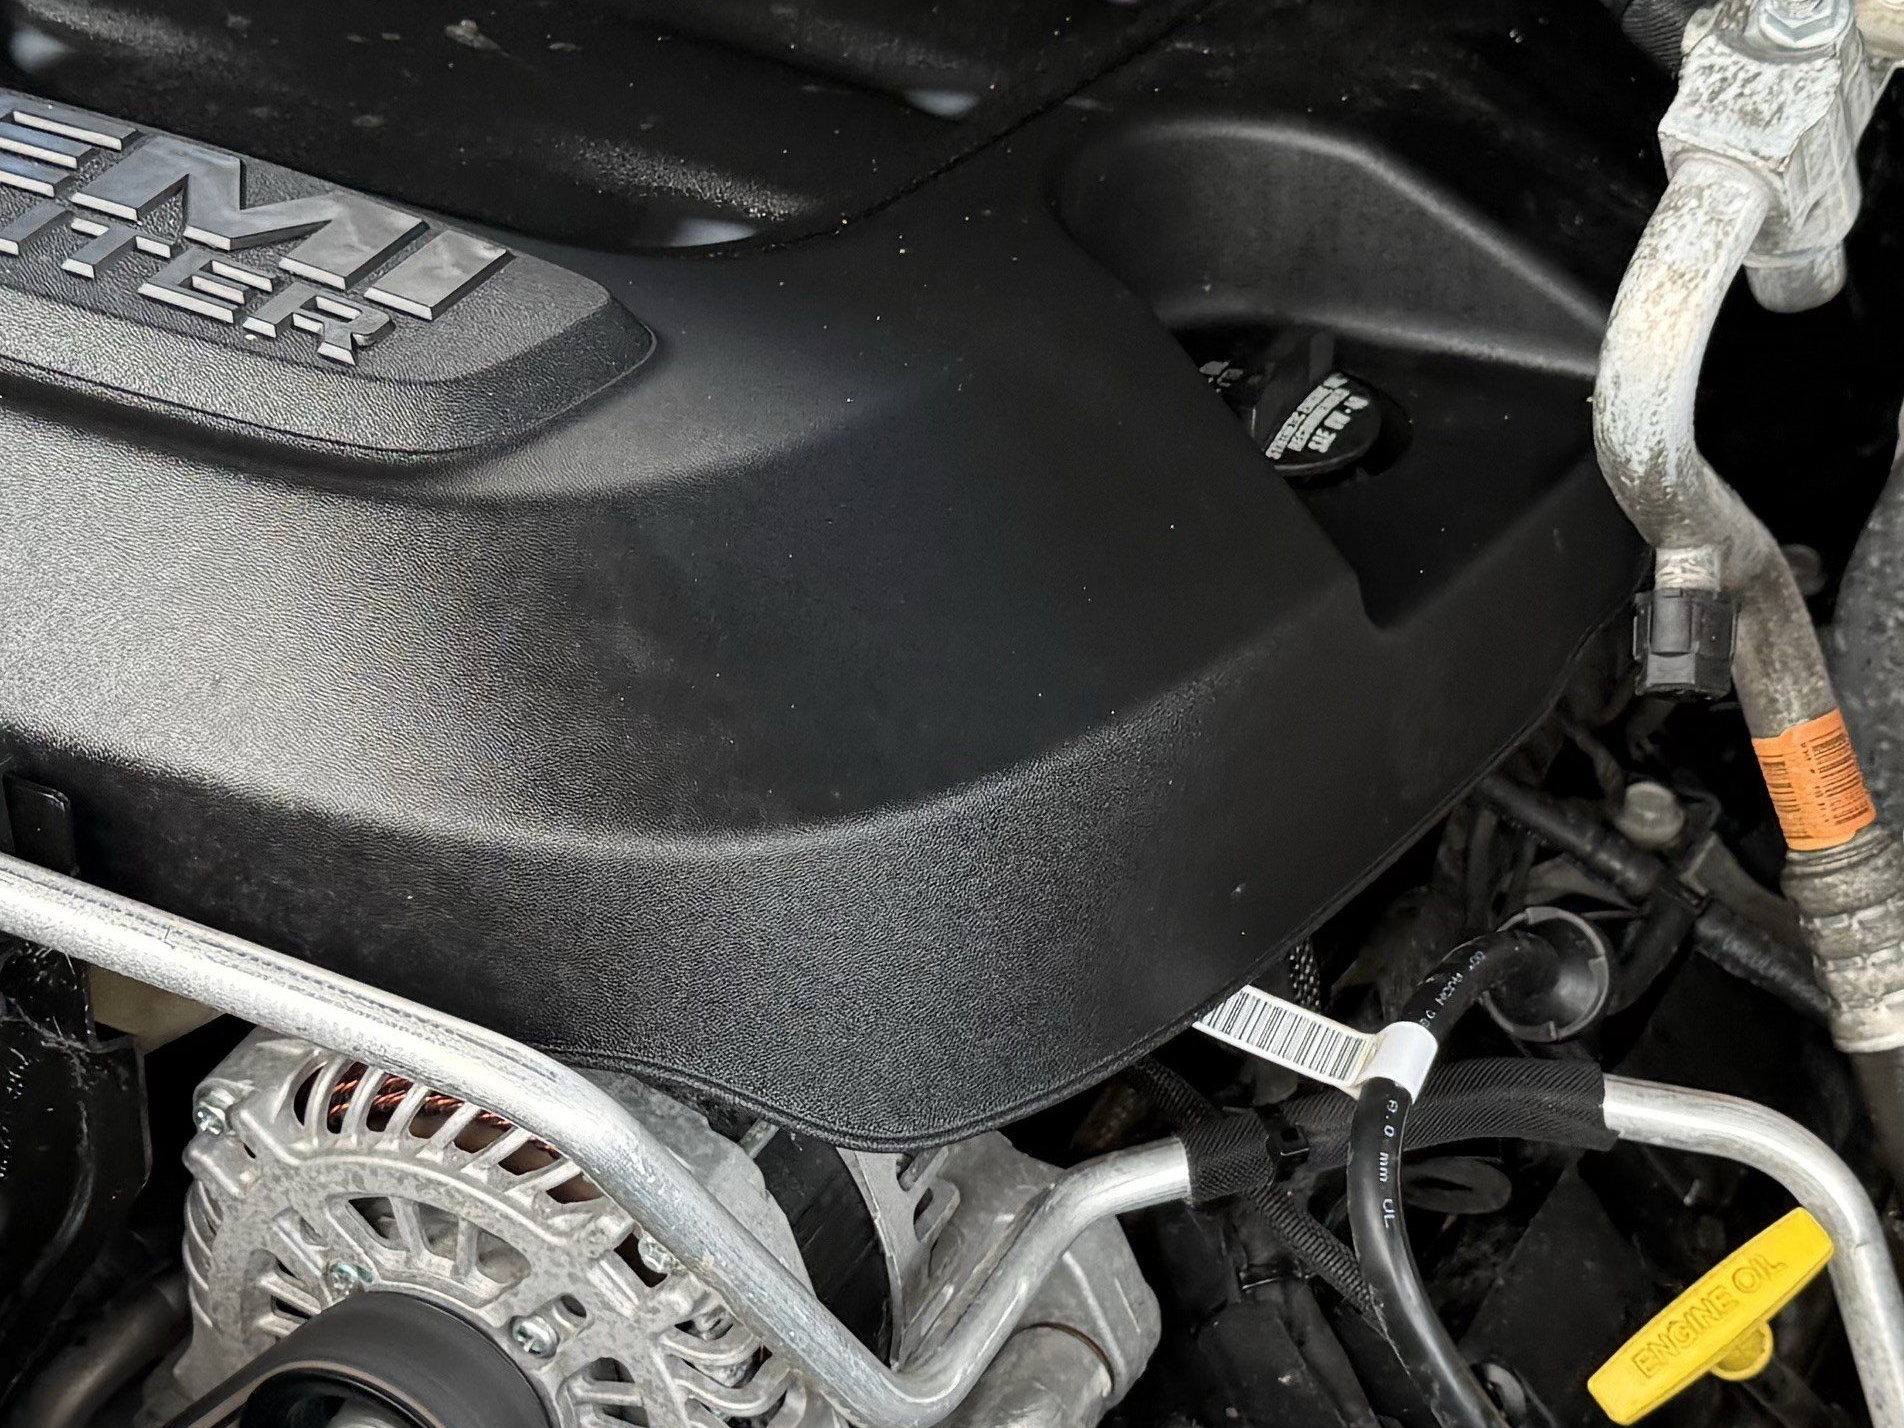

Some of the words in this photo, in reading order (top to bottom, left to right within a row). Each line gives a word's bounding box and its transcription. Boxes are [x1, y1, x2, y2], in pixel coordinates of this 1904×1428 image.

[1378, 1151, 1390, 1184] mm
[1381, 1197, 1396, 1230] UL
[1631, 1284, 1741, 1379] ENGINE
[1731, 1253, 1789, 1294] OIL
